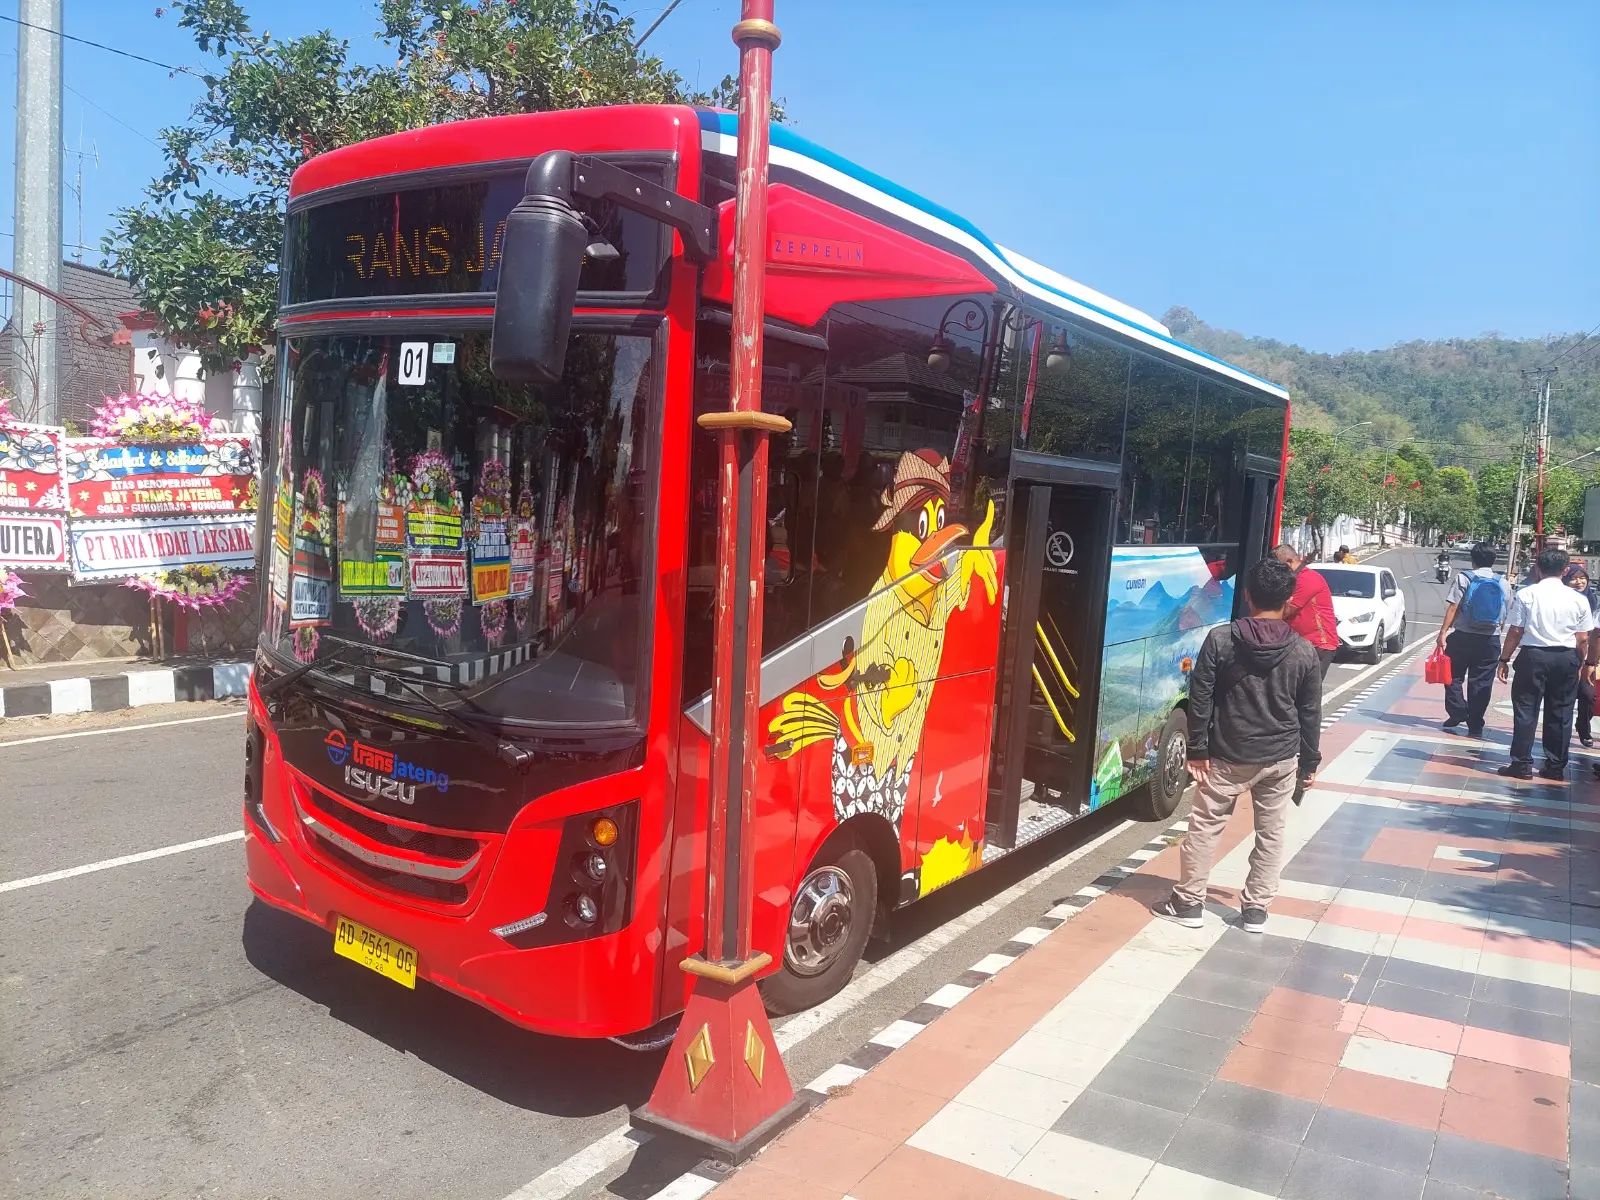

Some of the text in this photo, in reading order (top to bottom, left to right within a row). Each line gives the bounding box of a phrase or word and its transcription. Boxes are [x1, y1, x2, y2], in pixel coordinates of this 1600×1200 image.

[775, 240, 862, 261] ZEPPELIN
[403, 348, 424, 379] 01
[89, 448, 210, 470] Selamat & Sukses
[111, 477, 212, 491] ATAS BEROPERASINYA
[102, 487, 222, 504] BRT TRANS JATENG
[97, 504, 125, 515] SOLO
[131, 501, 187, 513] SUKOHARJO
[190, 499, 234, 511] WONOGIRI
[110, 533, 148, 560] RAYA
[147, 530, 192, 558] INDAH
[192, 527, 254, 554] LAKSANA
[344, 765, 416, 805] ISUZU
[338, 921, 355, 945] AD
[360, 929, 390, 963] 7561
